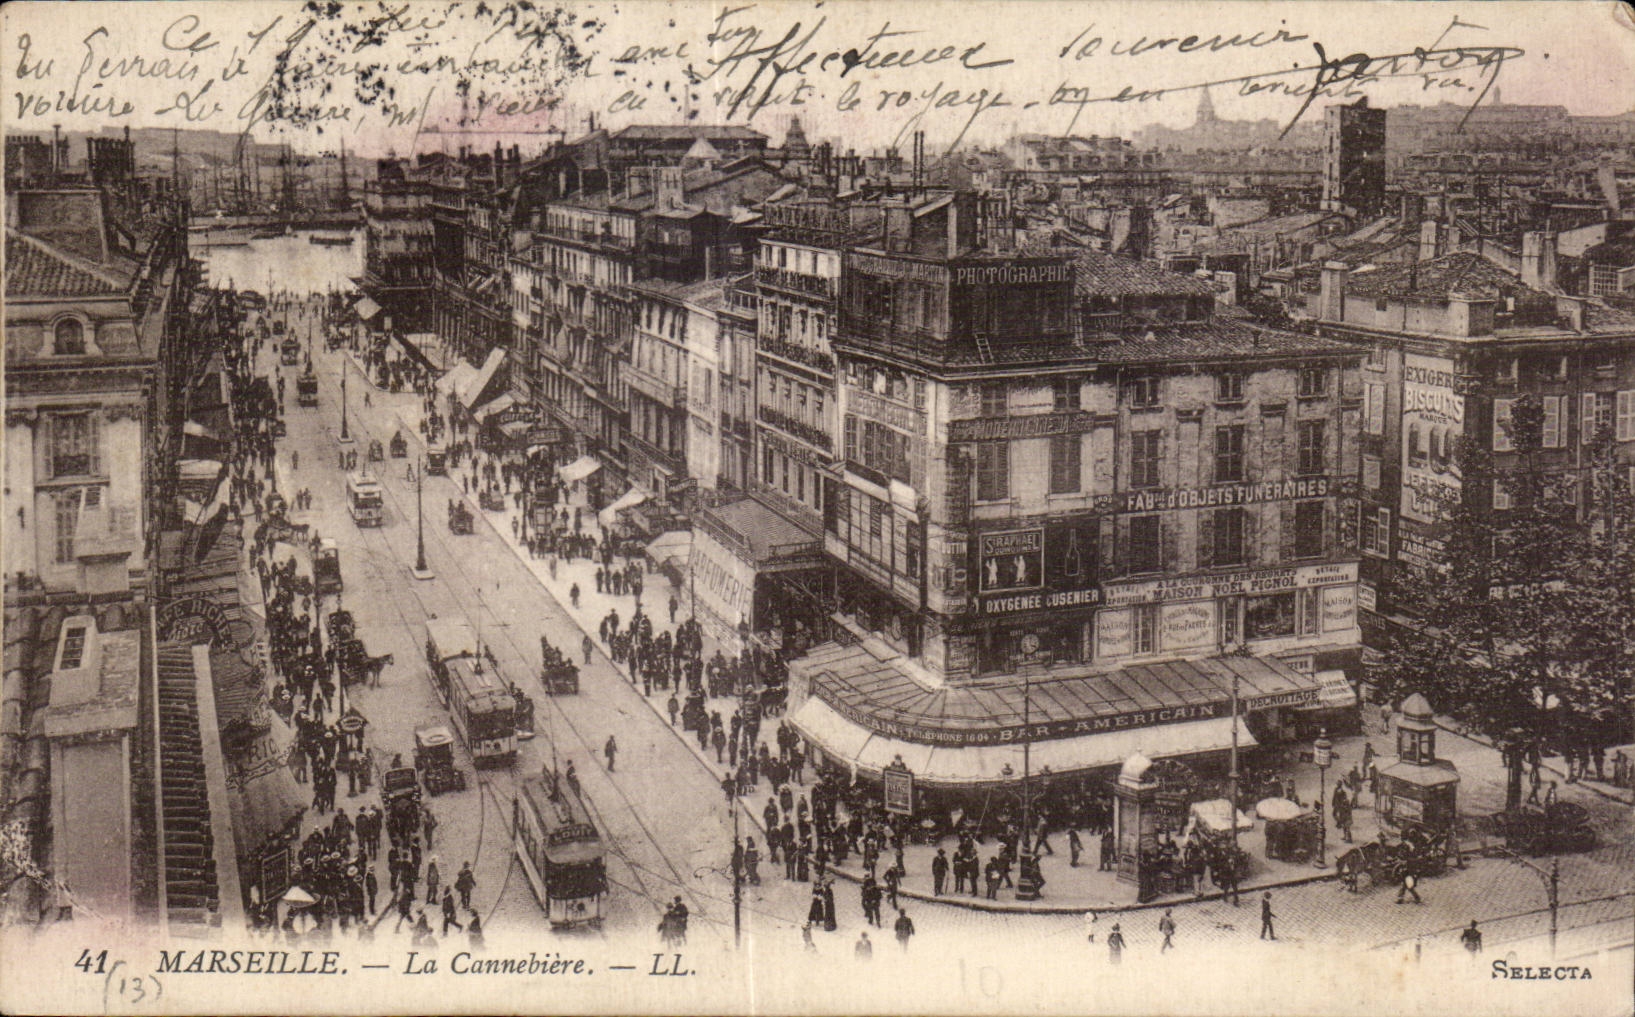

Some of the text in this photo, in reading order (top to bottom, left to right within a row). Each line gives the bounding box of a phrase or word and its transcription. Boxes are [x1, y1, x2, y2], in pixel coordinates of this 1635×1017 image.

[957, 264, 1070, 286] PHOTOGRAPHIE
[1238, 479, 1327, 502] FUNERAIRES
[1152, 586, 1203, 600] MAISON
[1250, 577, 1298, 592] PIGNOL
[1181, 575, 1230, 586] COURONNE
[1047, 588, 1099, 607] CUSENIER
[1000, 725, 1050, 741] BAR
[1074, 704, 1215, 732] AMERICAIN
